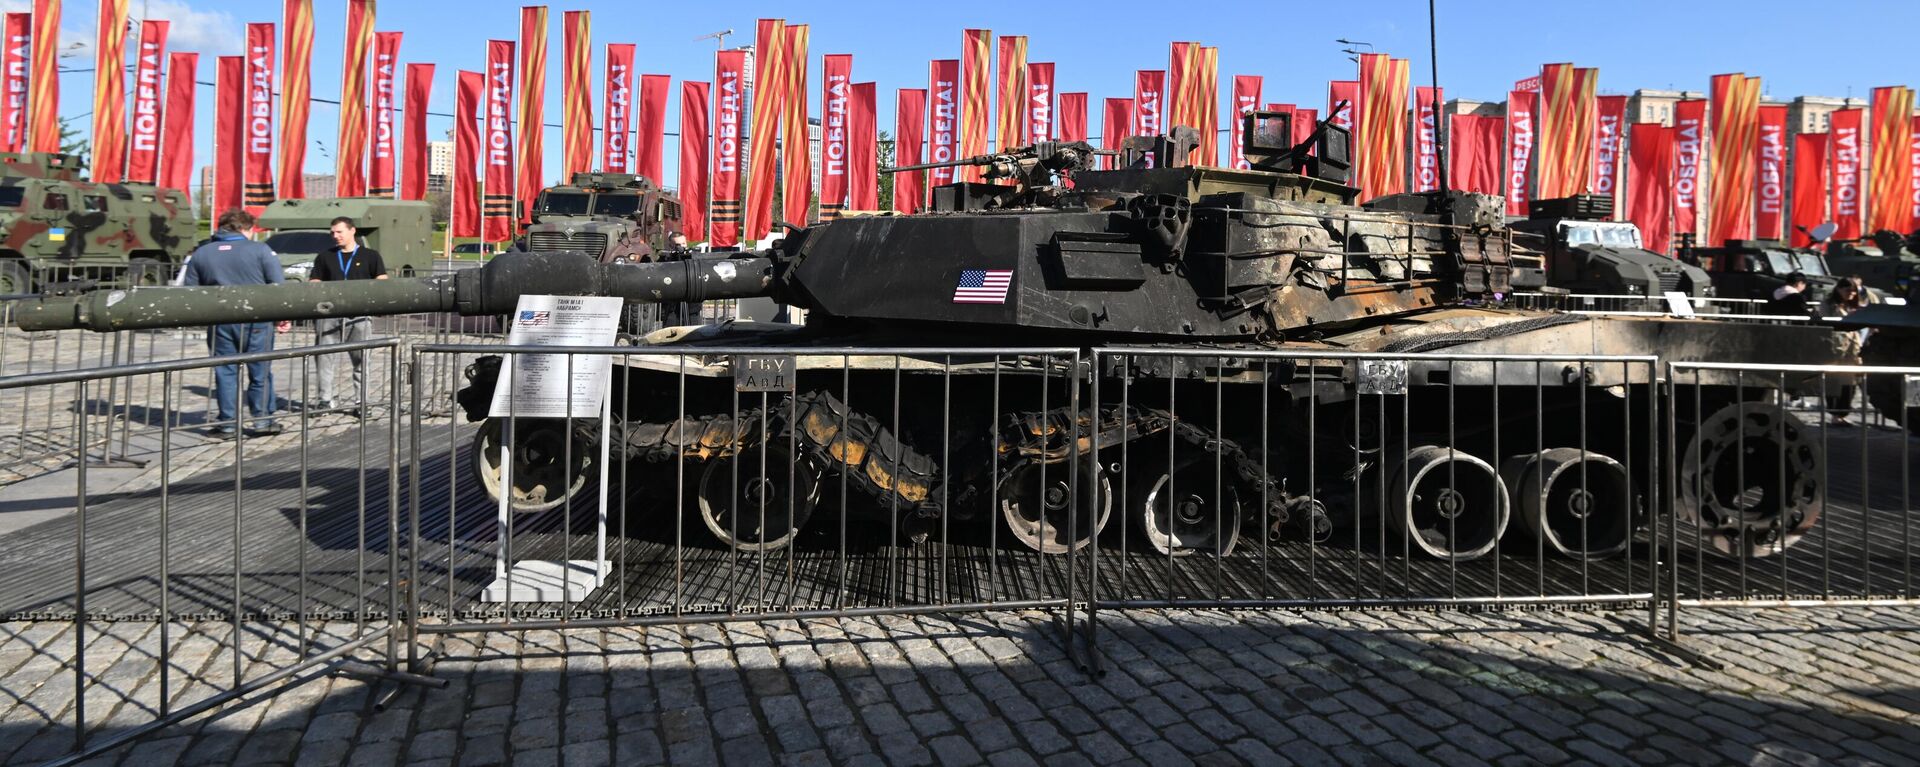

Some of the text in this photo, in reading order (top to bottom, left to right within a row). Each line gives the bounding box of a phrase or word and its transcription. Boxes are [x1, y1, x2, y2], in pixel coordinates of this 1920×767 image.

[135, 42, 159, 151] ПОБЕДА!
[251, 46, 270, 153] ПОБЕДА!
[376, 53, 393, 158] ПОБЕДА!
[490, 62, 509, 166] ПОБЕДА!
[609, 64, 628, 167] ПОБЕДА!
[720, 71, 739, 172] ПОБЕДА!
[827, 74, 847, 175] ПОБЕДА!
[935, 81, 955, 179] ПОБЕДА!
[1032, 83, 1050, 143] БЕДА!
[1512, 111, 1533, 202] ПОБЕДА!
[1597, 115, 1619, 194] ОБЕДА!
[1676, 118, 1700, 208] ПОБЕДА!
[1762, 124, 1782, 213] ПОБЕДА!
[1837, 127, 1860, 215] ПОБЕДА!
[748, 359, 785, 373] ГБУ
[1368, 364, 1399, 377] ГБУ
